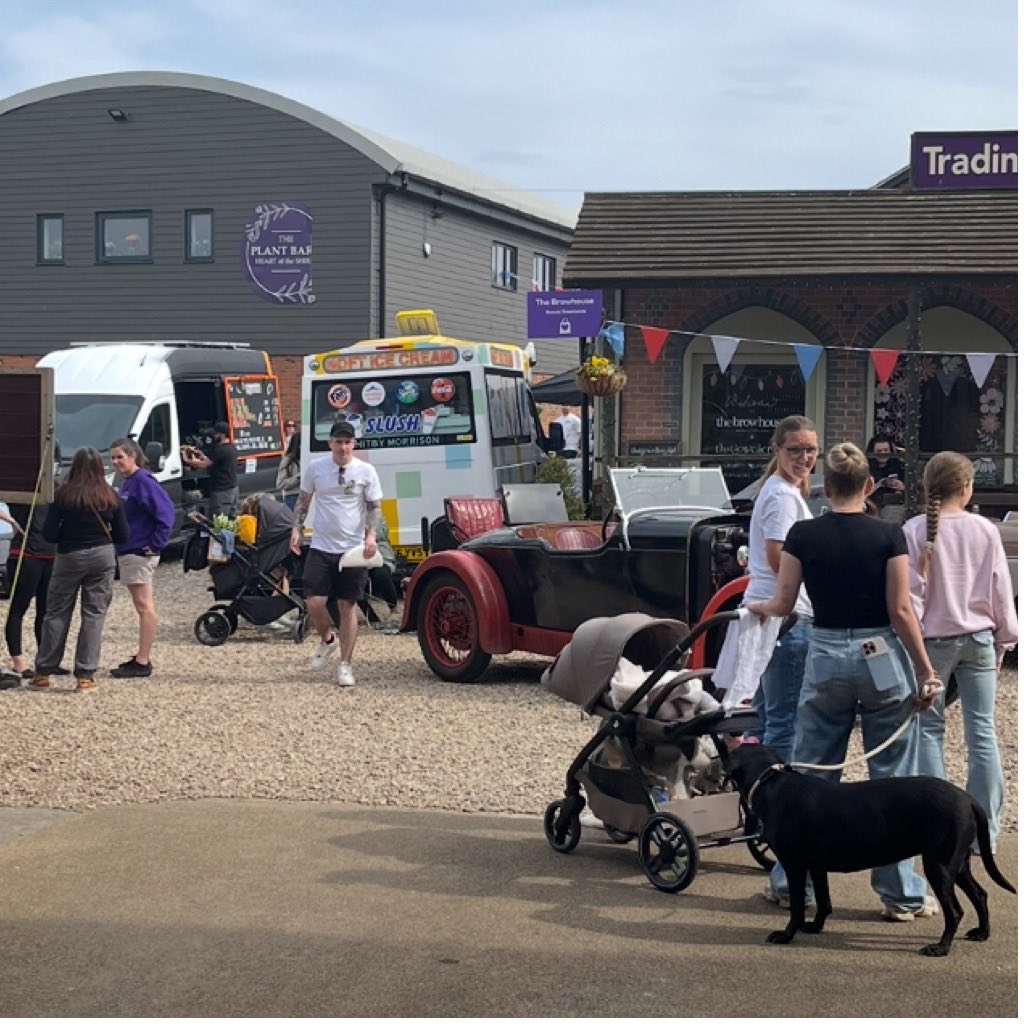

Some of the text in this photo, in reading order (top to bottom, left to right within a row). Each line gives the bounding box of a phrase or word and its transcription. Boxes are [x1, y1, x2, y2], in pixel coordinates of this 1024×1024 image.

[922, 142, 1018, 175] Tradin
[250, 247, 288, 255] PLANT
[536, 297, 550, 306] The
[398, 349, 454, 367] CREAM
[366, 413, 421, 434] SLUSH
[732, 416, 781, 428] browhous
[356, 436, 440, 447] HITBY MORRISON
